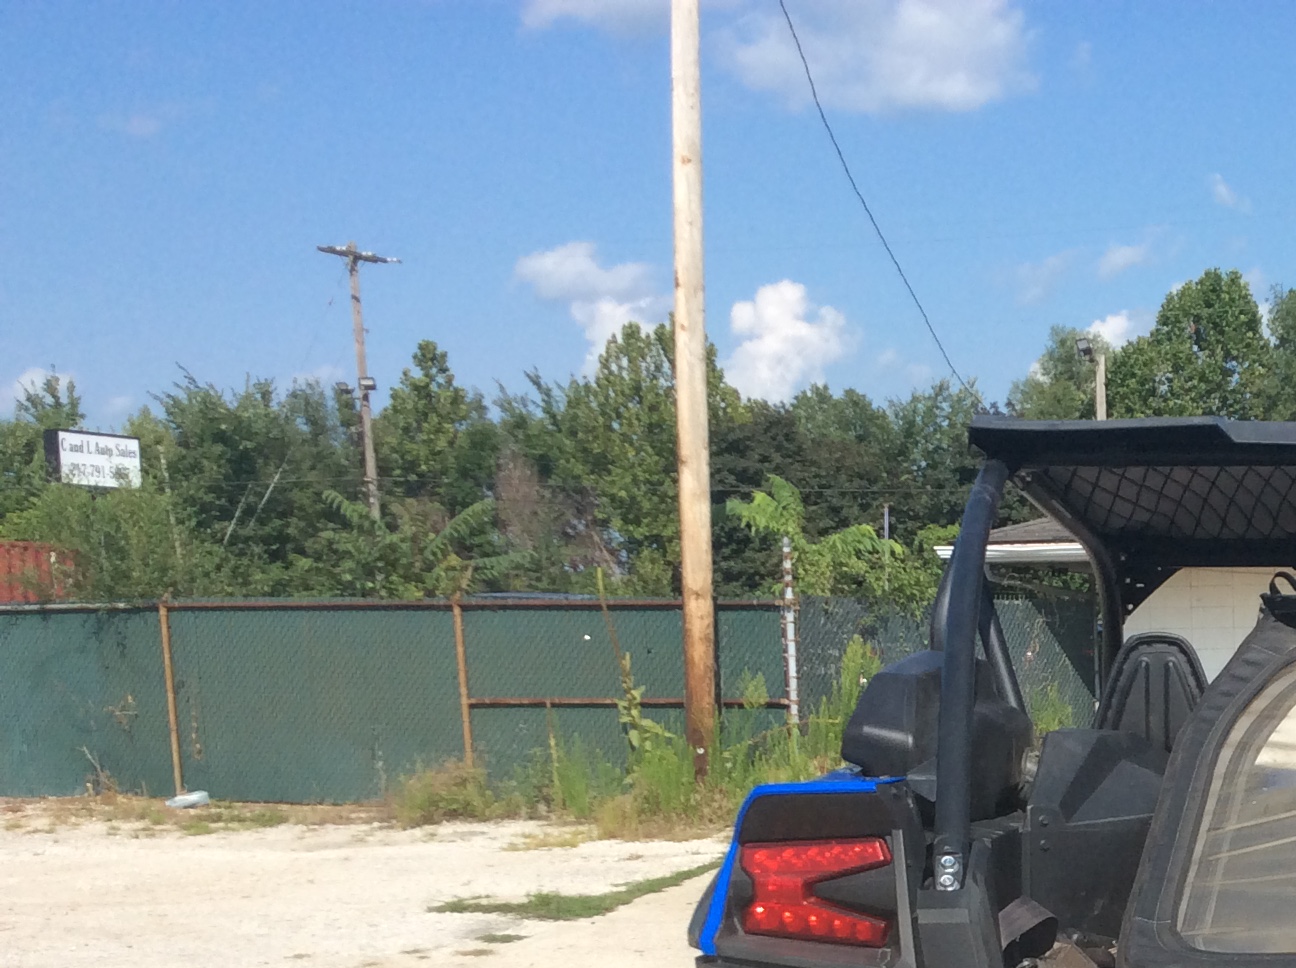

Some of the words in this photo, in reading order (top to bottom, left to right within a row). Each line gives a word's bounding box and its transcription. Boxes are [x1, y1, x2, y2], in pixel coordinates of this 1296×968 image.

[61, 438, 67, 452] C
[69, 440, 84, 453] and
[115, 443, 137, 458] Sales
